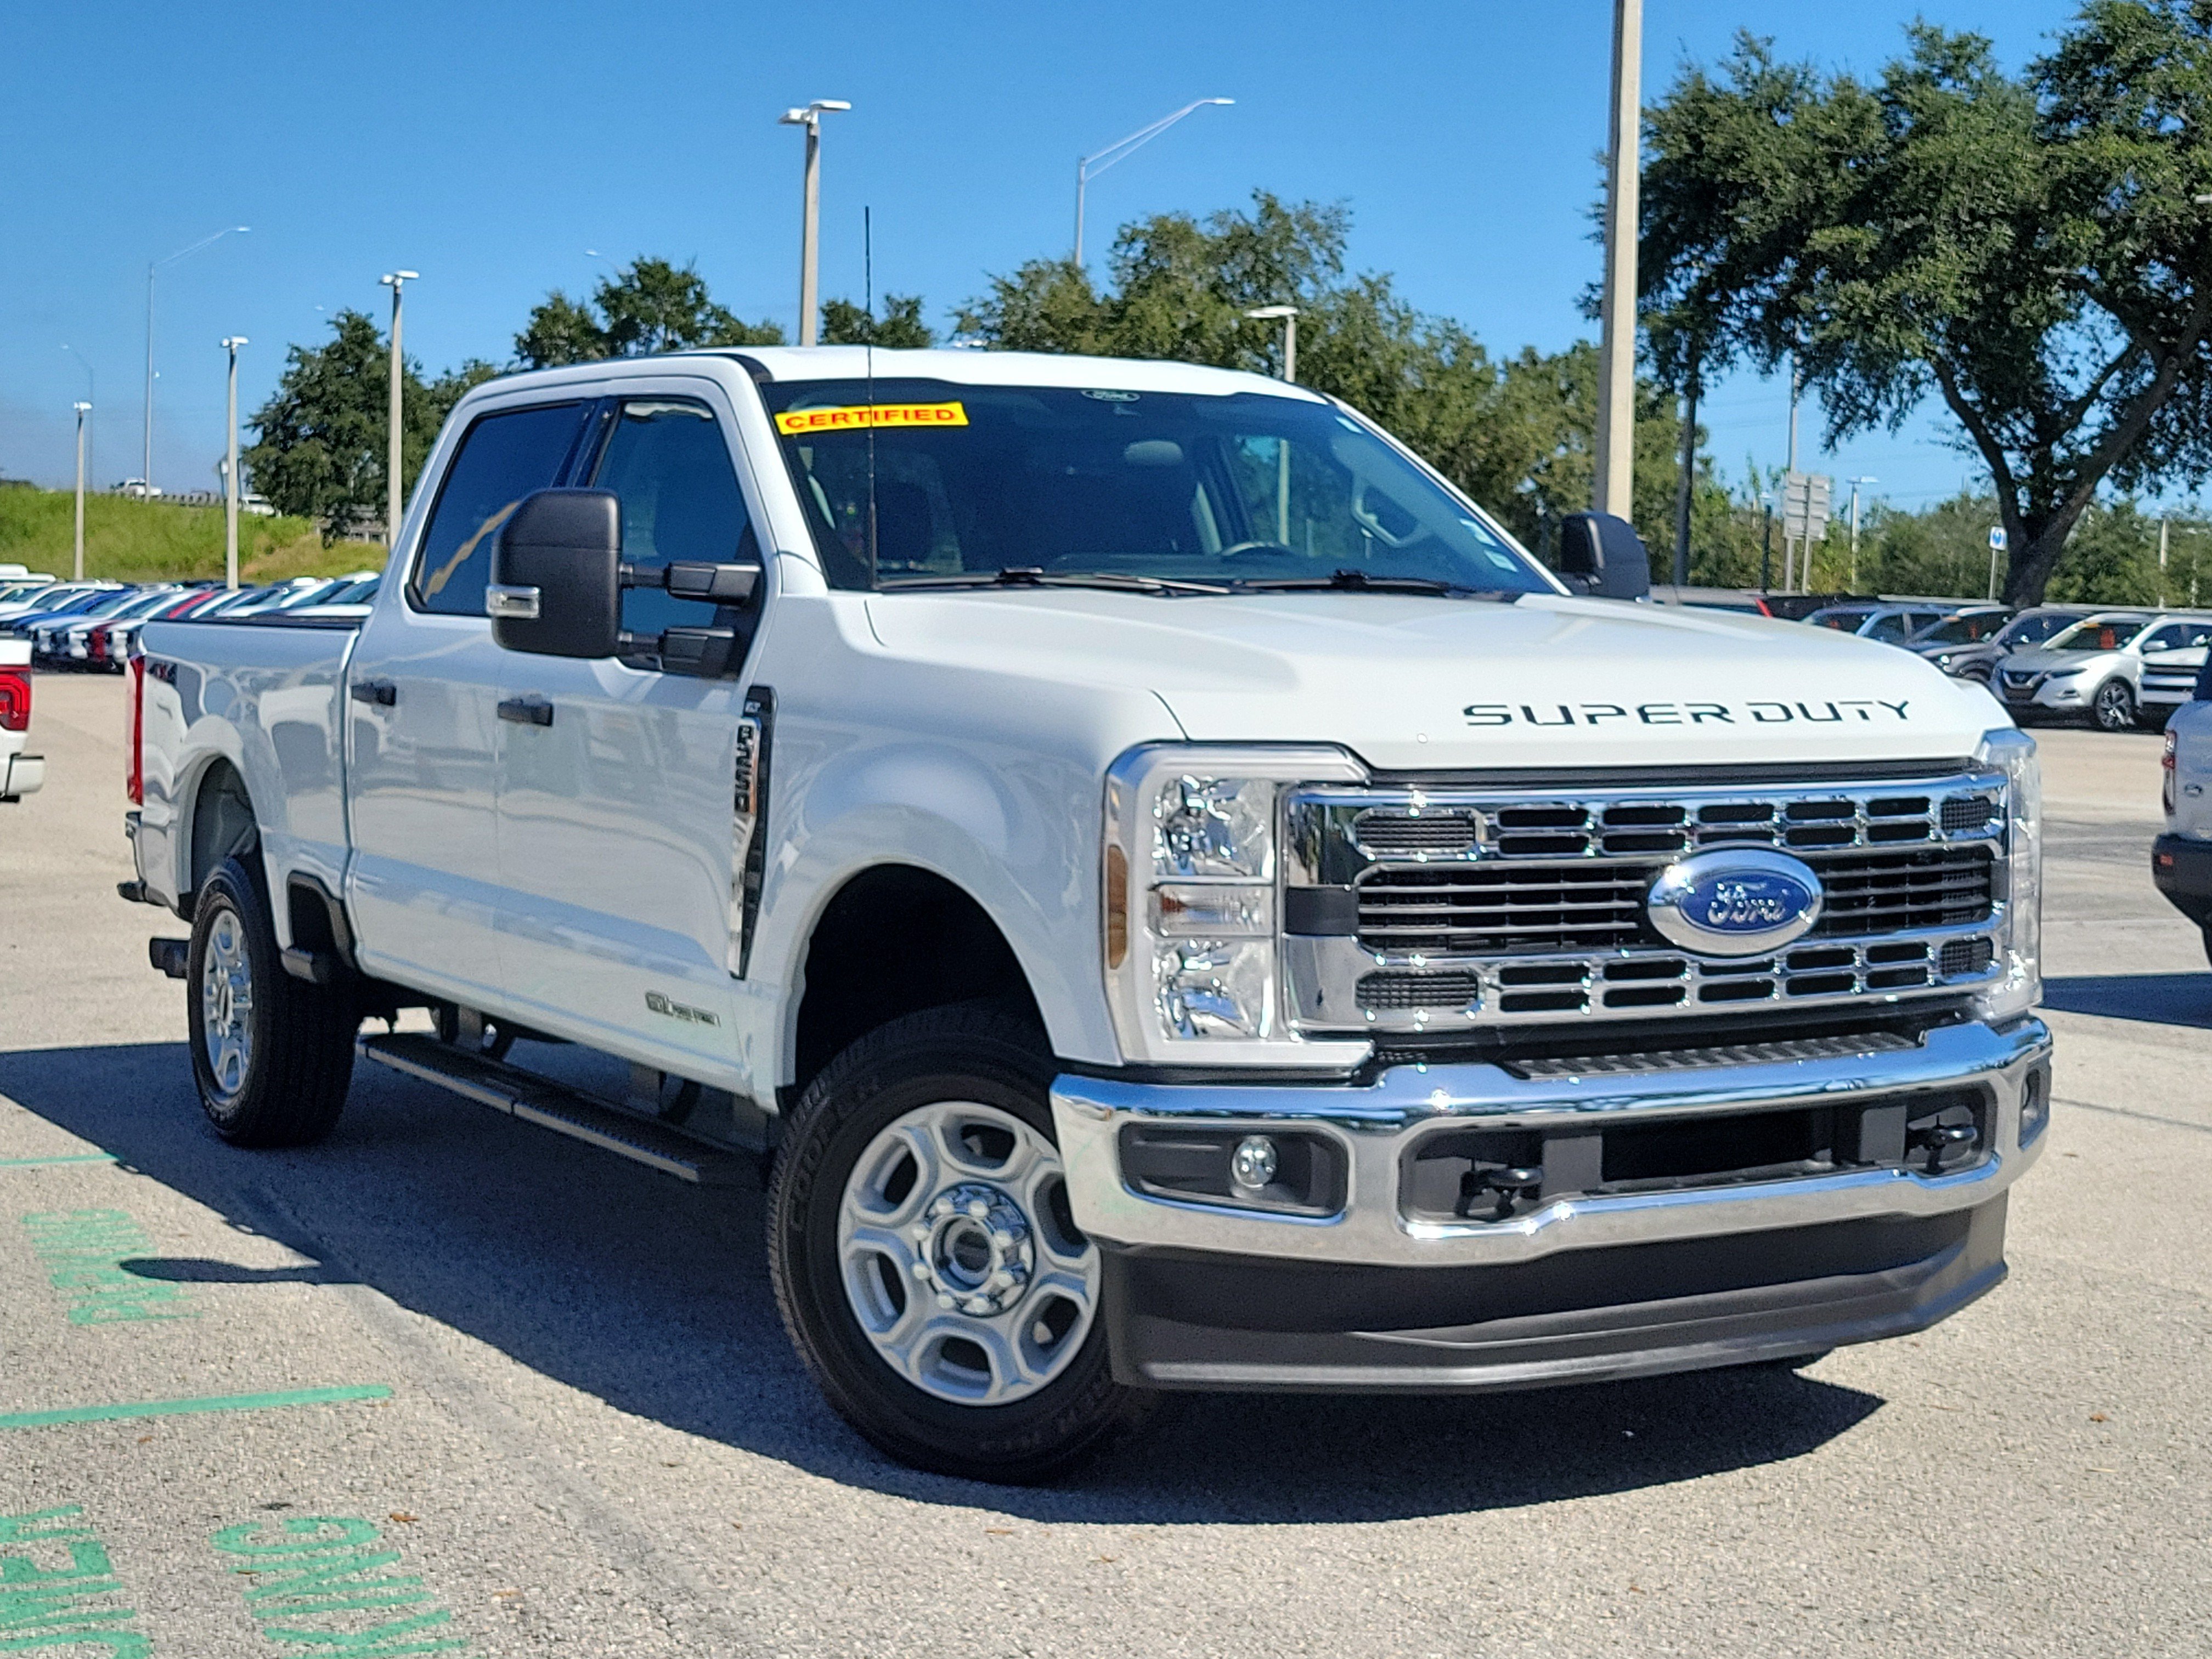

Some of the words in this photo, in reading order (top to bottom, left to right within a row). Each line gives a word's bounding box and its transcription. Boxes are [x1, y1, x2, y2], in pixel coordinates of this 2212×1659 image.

[786, 409, 954, 427] CERTIFIED
[1462, 703, 1735, 726] SUPER
[1745, 700, 1910, 723] DUTY
[1706, 881, 1791, 925] Ford
